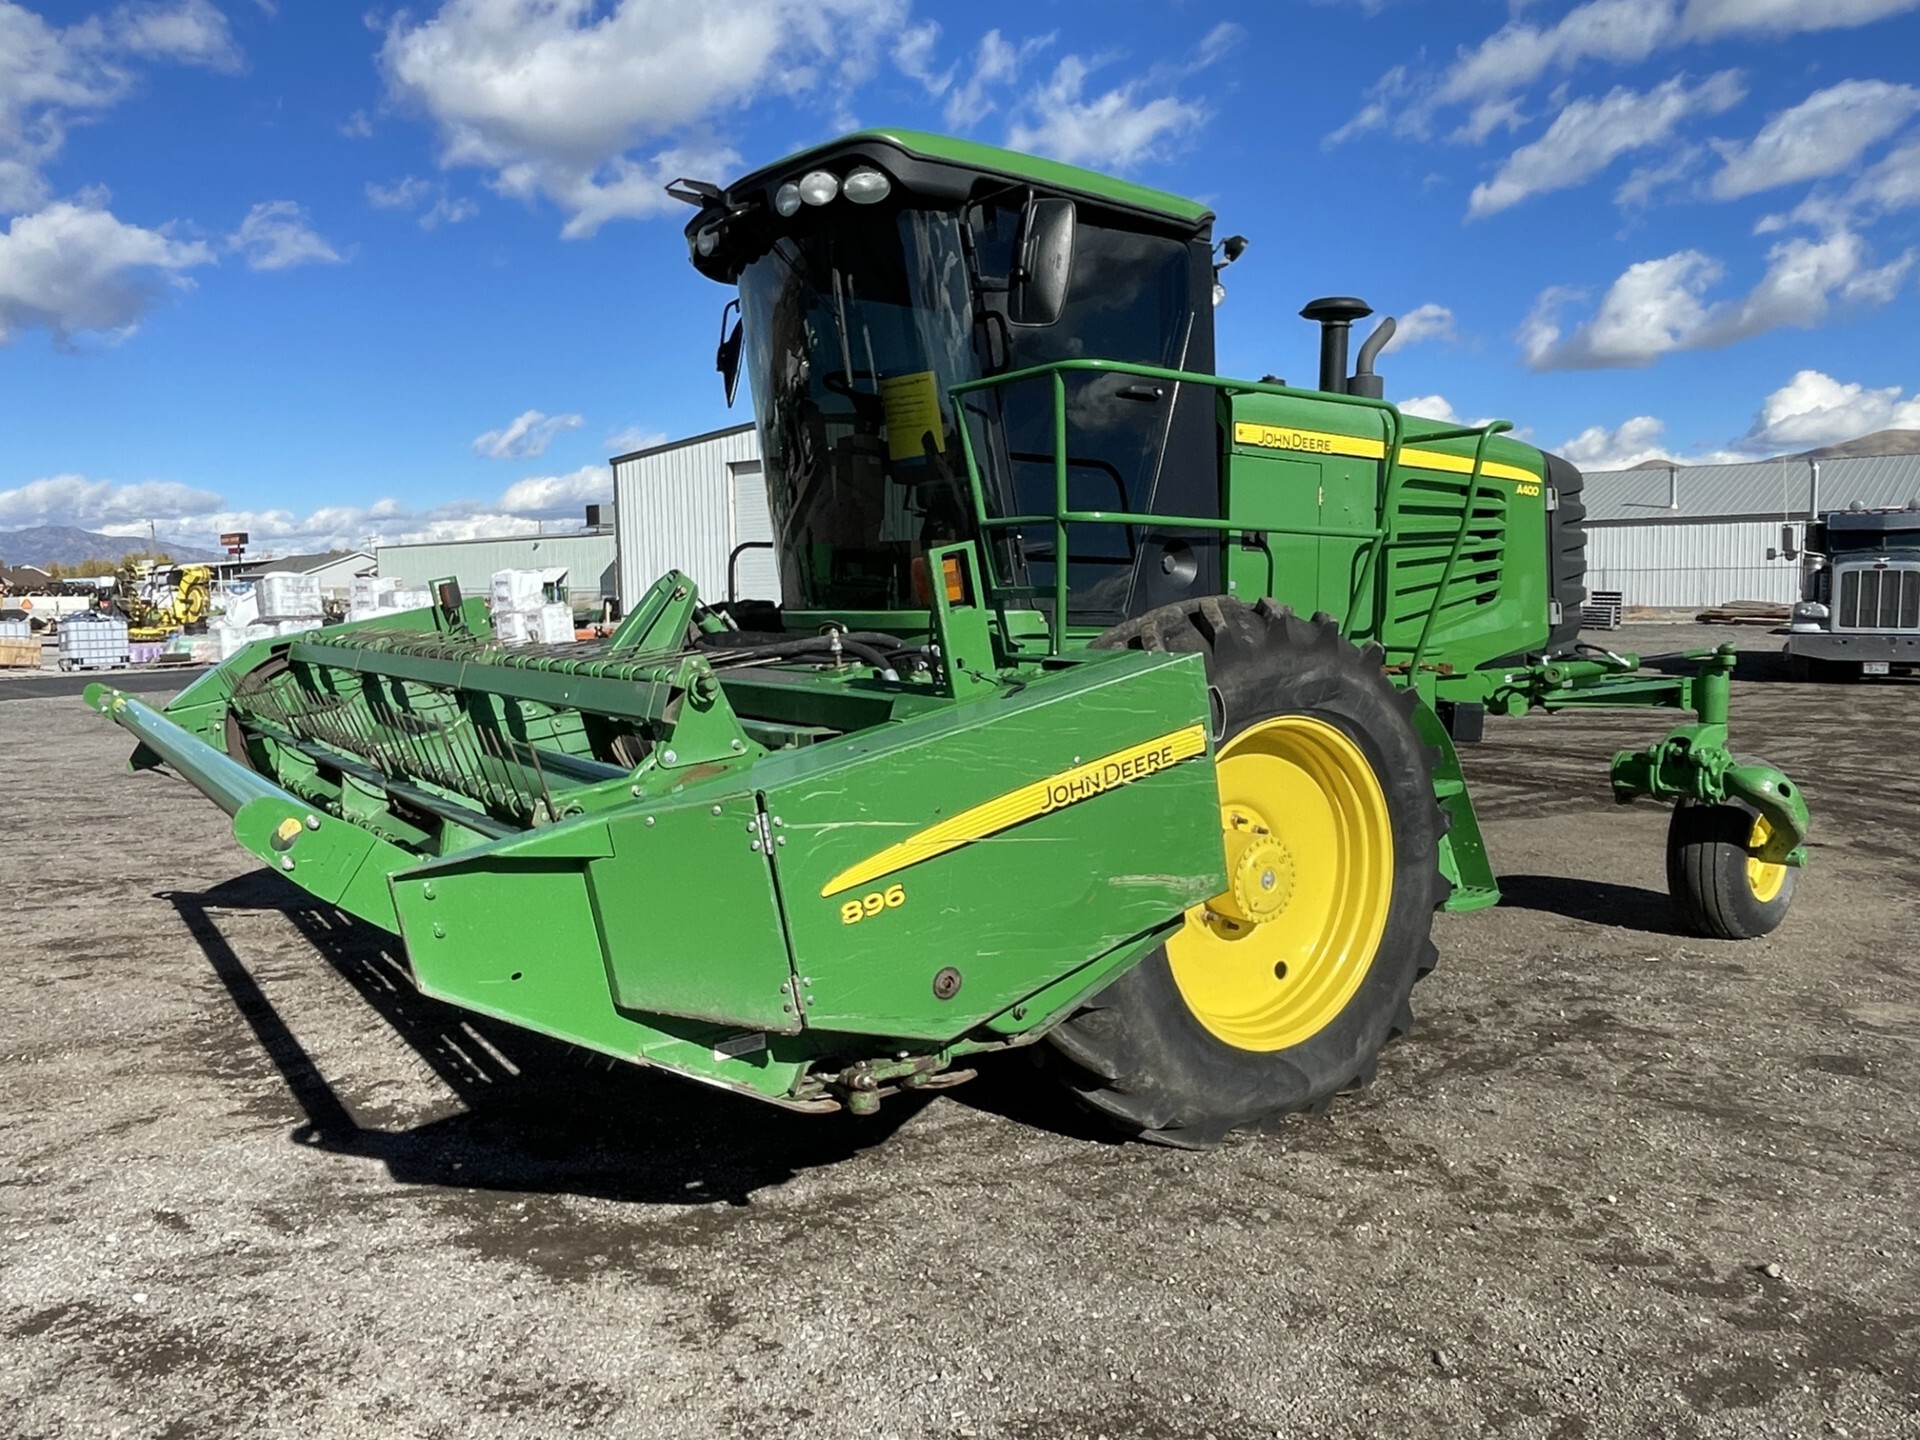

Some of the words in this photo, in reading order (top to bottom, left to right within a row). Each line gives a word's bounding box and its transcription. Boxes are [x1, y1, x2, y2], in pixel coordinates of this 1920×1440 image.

[1258, 430, 1290, 446] JOHN
[1292, 433, 1331, 451] DEERE
[1516, 484, 1539, 496] A400
[1041, 776, 1100, 810] JOHN
[1103, 746, 1174, 786] DEERE
[841, 884, 906, 924] 896
